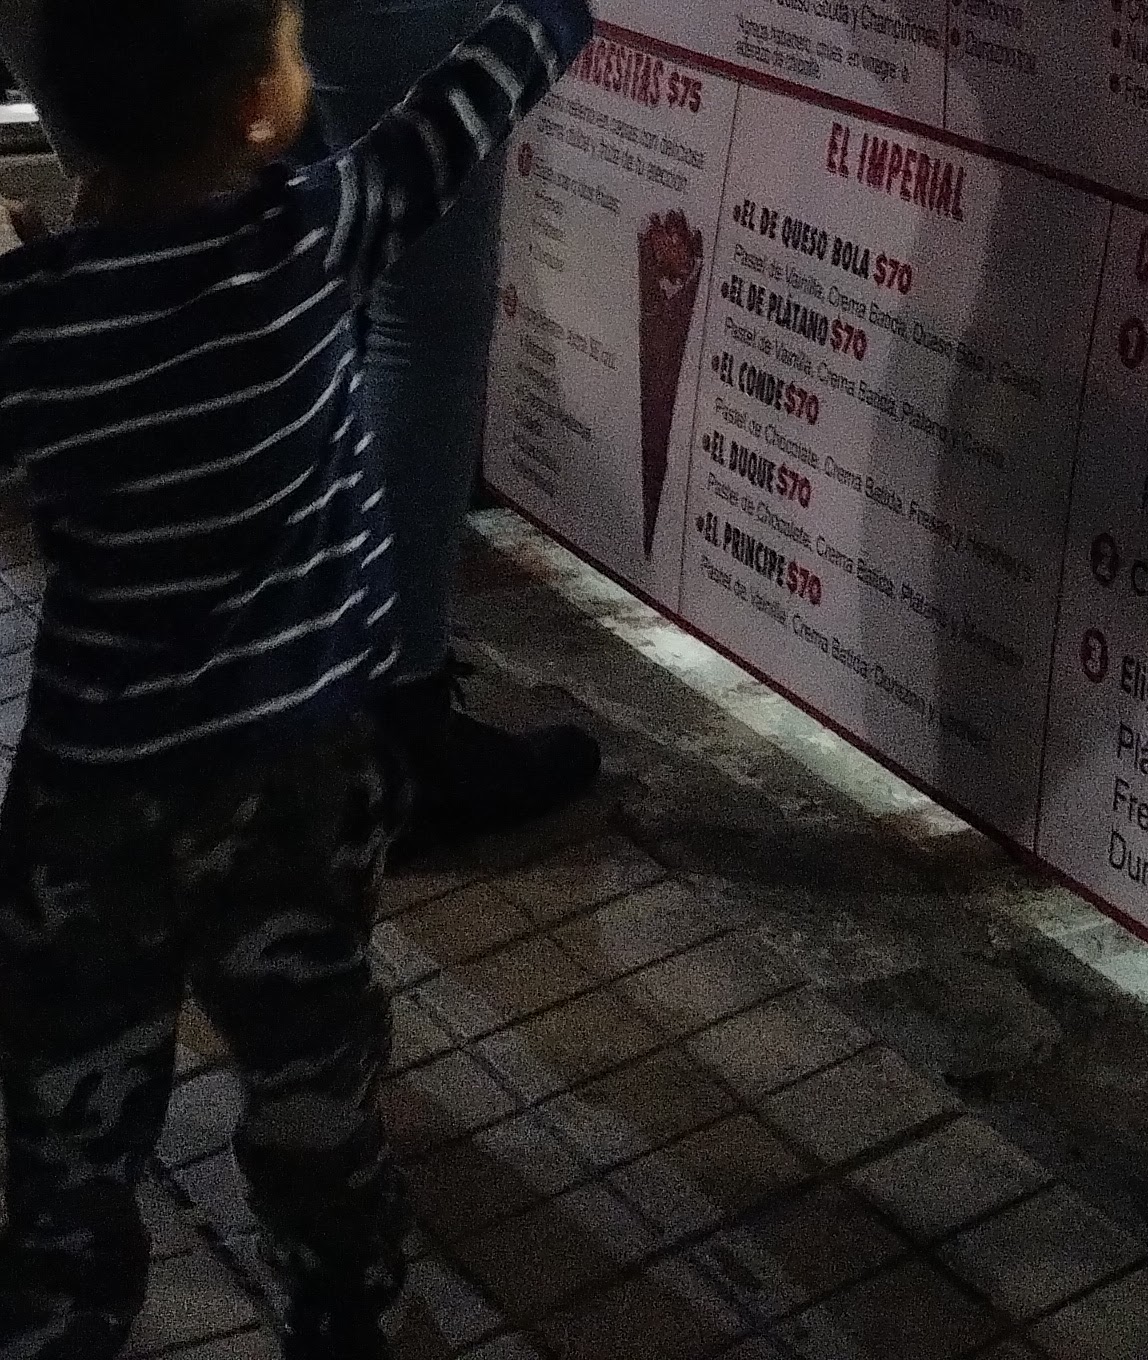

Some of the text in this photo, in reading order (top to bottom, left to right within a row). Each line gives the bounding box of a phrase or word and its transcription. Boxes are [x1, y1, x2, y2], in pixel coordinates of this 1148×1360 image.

[667, 71, 703, 114] $75
[826, 122, 966, 222] EL IMPERIAL
[741, 199, 912, 295] EL DE QUESO BOLA $70
[729, 274, 867, 361] EL DE PLÁTANO $70
[720, 352, 819, 426] EL CONDE $70
[711, 430, 811, 508] EL DUQUE $70
[705, 511, 719, 547] EL
[787, 561, 822, 606] $70
